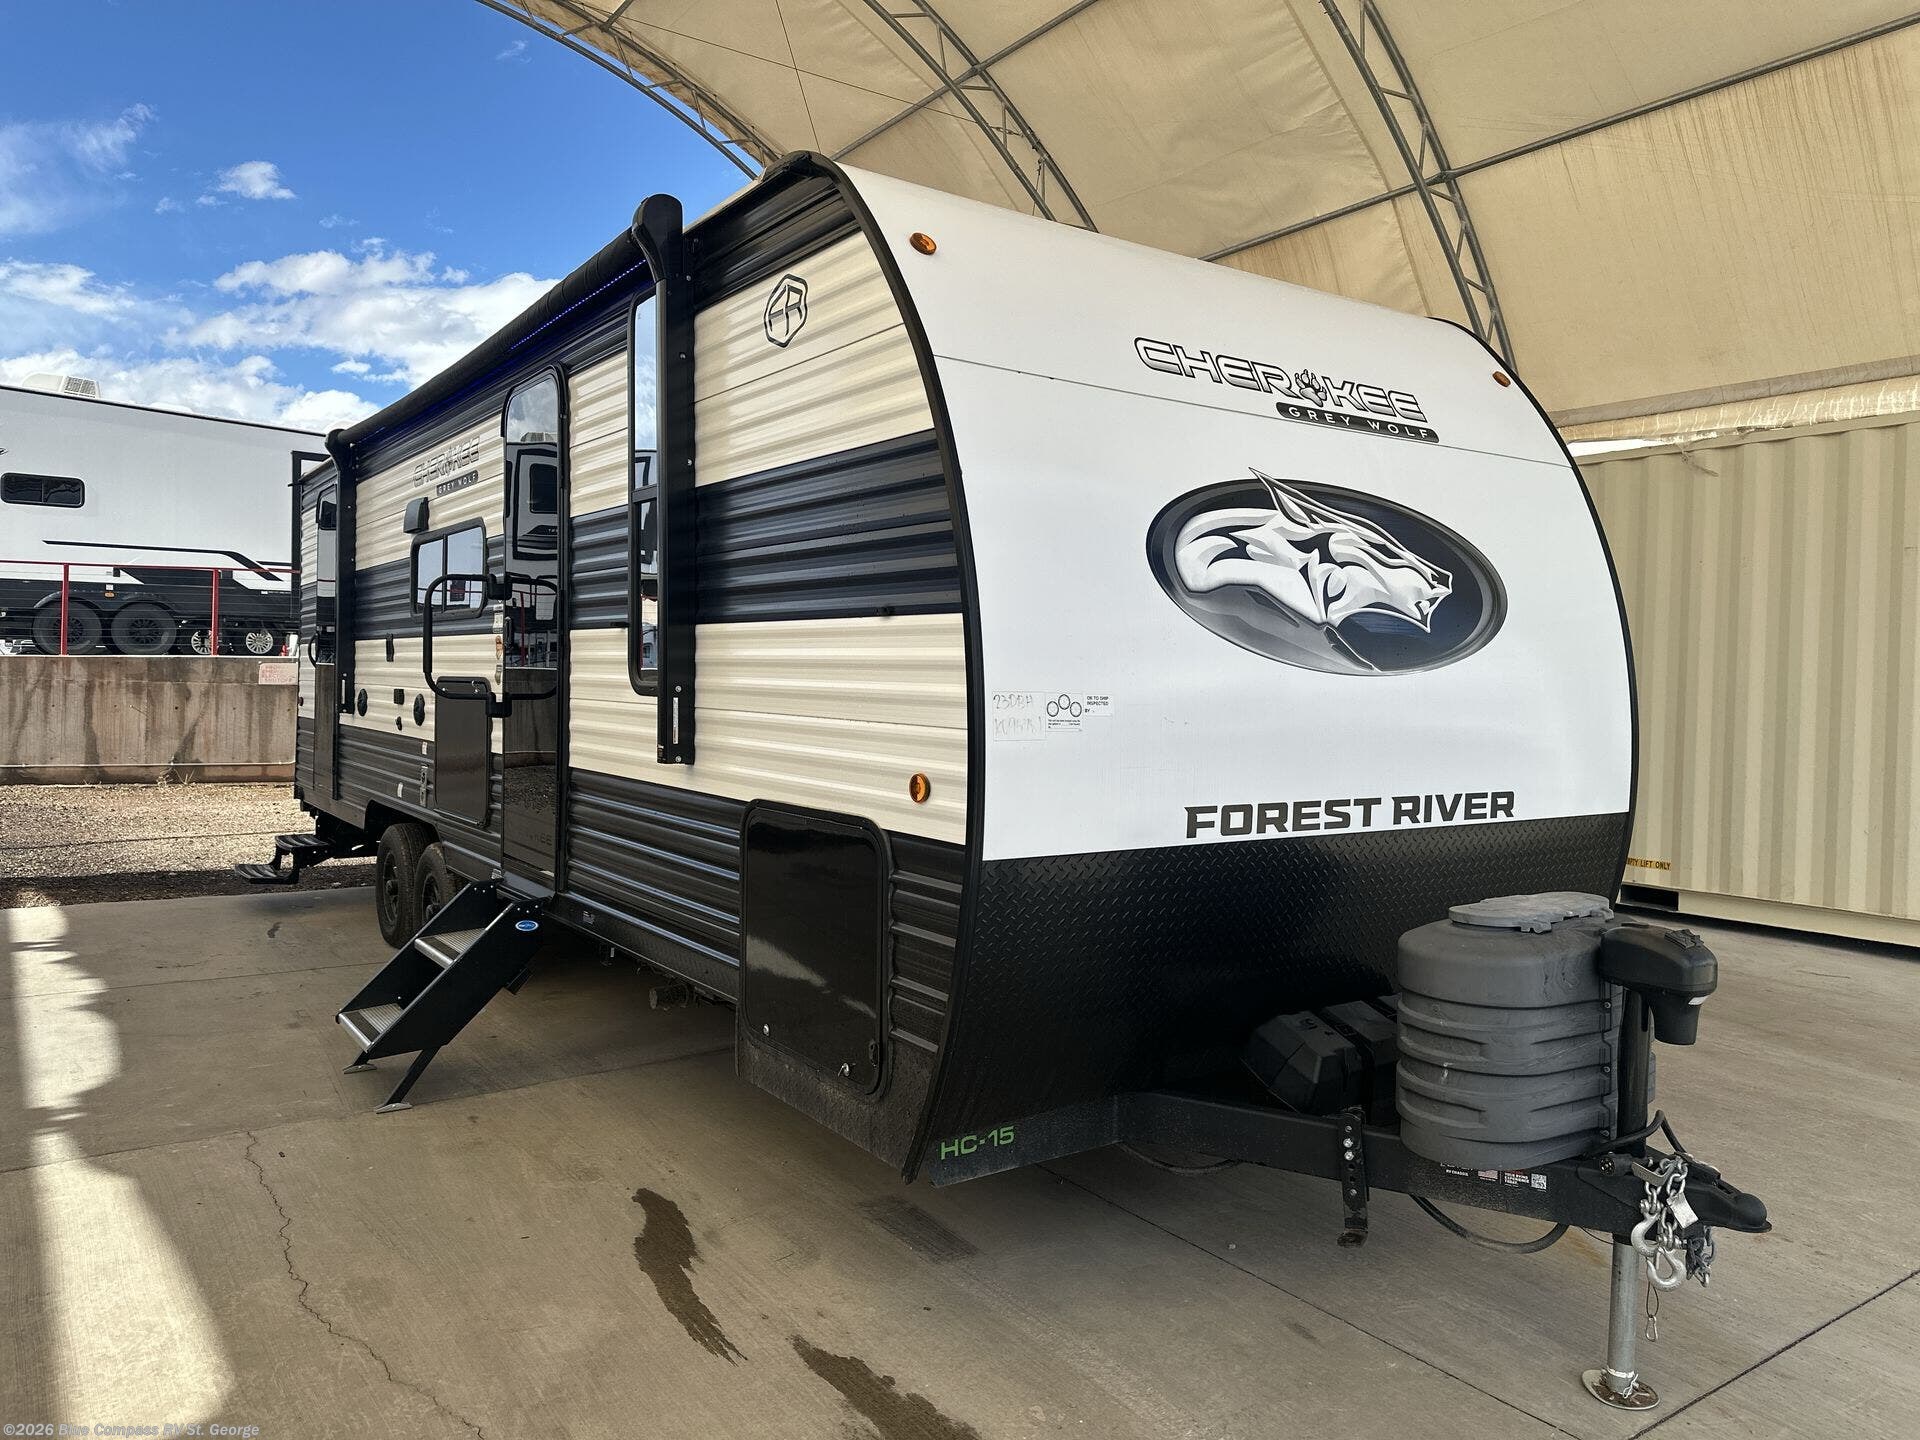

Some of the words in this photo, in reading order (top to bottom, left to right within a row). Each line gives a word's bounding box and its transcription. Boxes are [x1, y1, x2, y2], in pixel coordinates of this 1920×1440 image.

[1288, 405, 1350, 427] GREY
[1367, 419, 1428, 440] WOLF
[438, 482, 456, 495] GREY
[458, 472, 476, 486] WOLF
[1183, 797, 1382, 839] FOREST
[1391, 790, 1515, 826] RIVER
[1640, 860, 1653, 868] LIFT
[1655, 861, 1671, 870] ONLY
[940, 1125, 1015, 1161] HC-15
